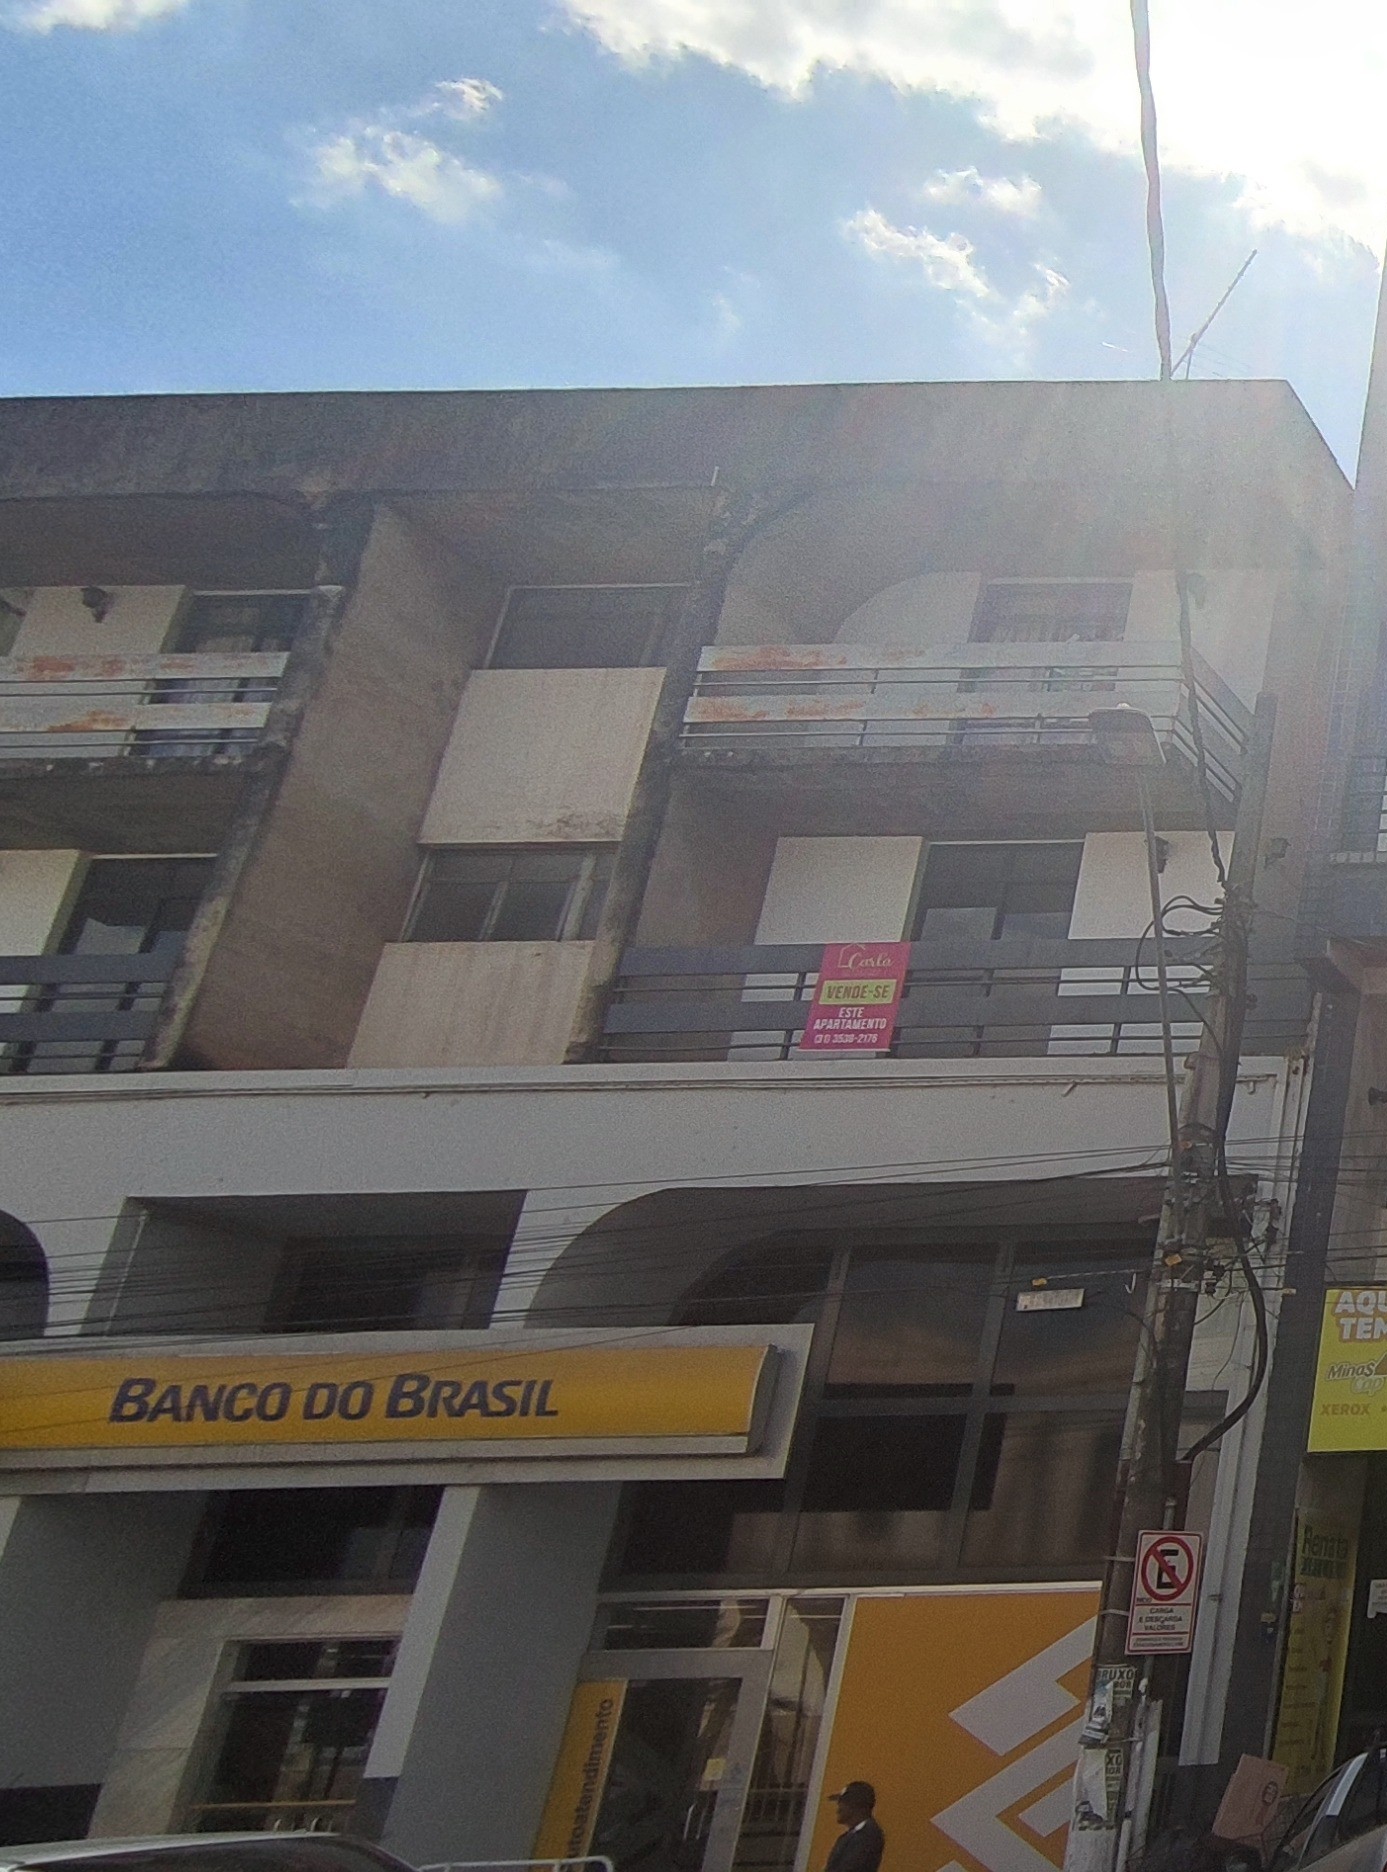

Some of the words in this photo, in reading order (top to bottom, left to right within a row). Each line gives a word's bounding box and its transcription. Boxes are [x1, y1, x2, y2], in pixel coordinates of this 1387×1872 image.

[827, 985, 890, 999] VENDE-SE
[838, 1006, 865, 1018] ESTE
[813, 1018, 887, 1030] APARTAMENTO
[1328, 1361, 1376, 1379] Minas
[108, 1377, 291, 1423] BANCO
[302, 1381, 375, 1421] DO
[385, 1373, 559, 1419] BRASIL
[1320, 1402, 1371, 1416] XEROX
